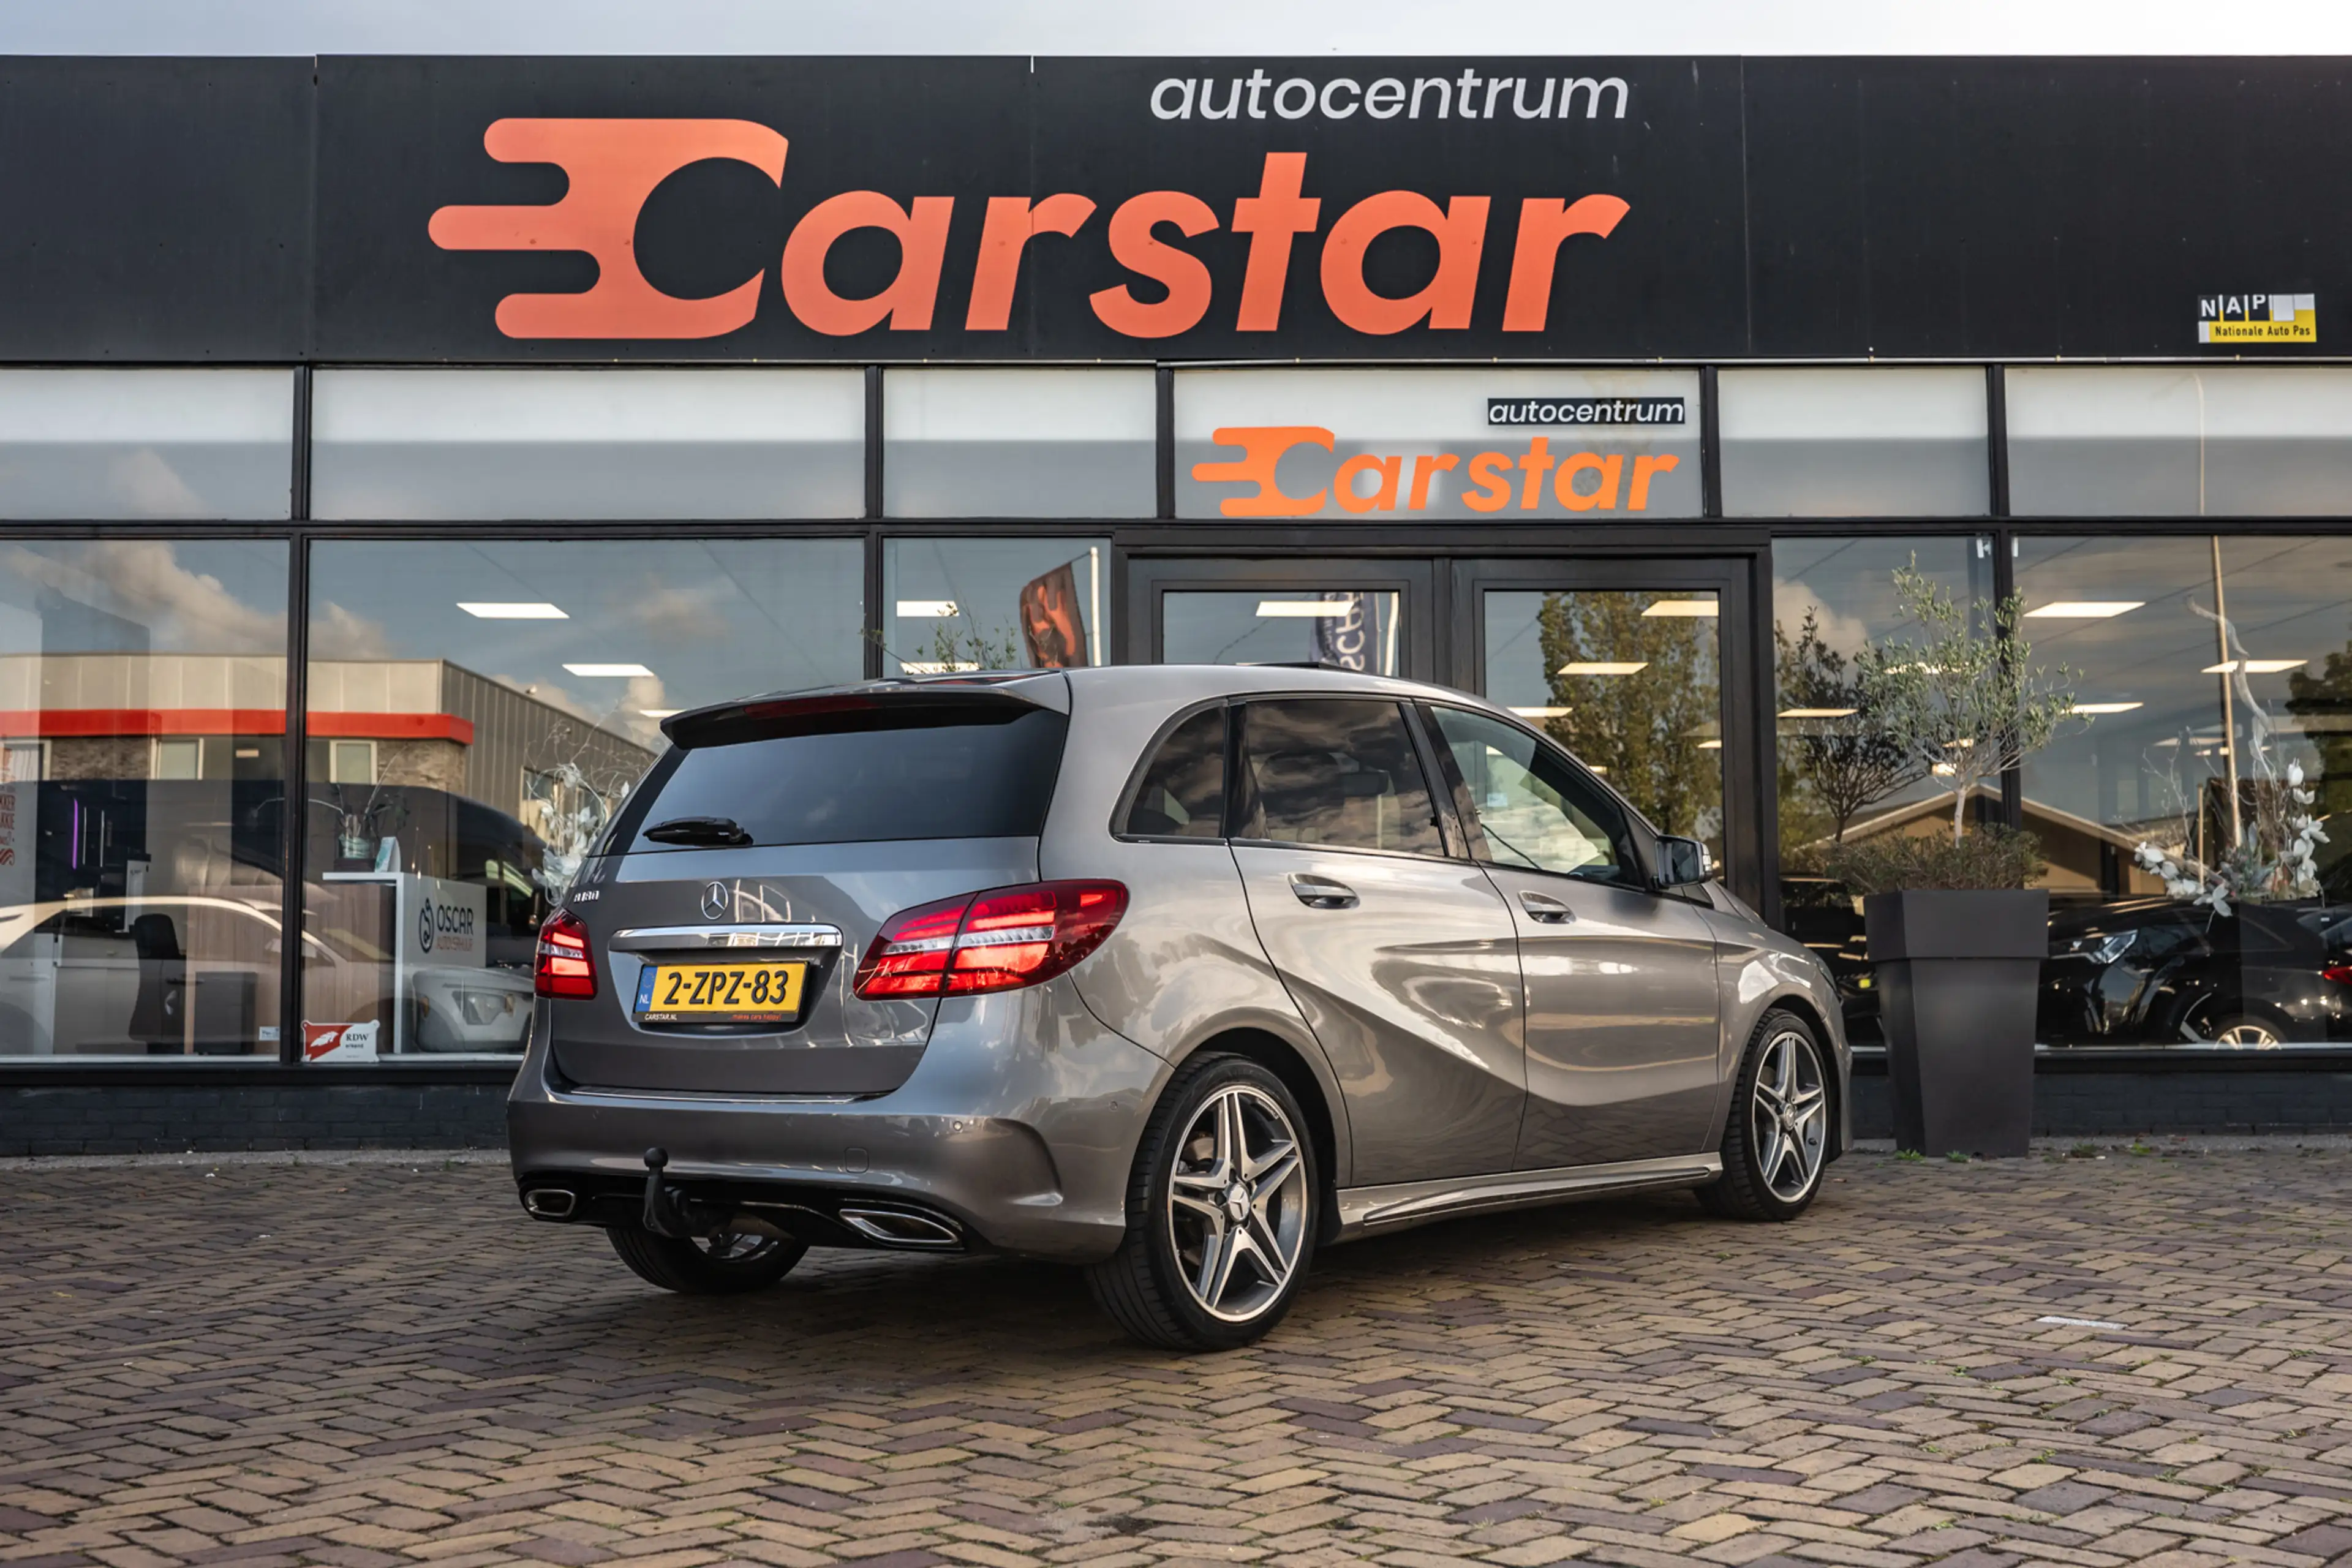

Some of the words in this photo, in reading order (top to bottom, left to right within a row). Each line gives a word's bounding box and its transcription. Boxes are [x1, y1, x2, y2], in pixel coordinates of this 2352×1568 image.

[1150, 69, 1629, 119] autocentrum
[428, 118, 1630, 339] Carstar
[2215, 326, 2263, 336] Nationale
[2267, 326, 2290, 335] Auto
[2293, 325, 2310, 335] Pas
[1489, 400, 1684, 423] autocentrum
[1191, 425, 1680, 518] Carstar
[437, 904, 473, 935] OSCAR
[639, 994, 649, 1004] NL
[663, 970, 788, 1005] 2-ZPZ-83
